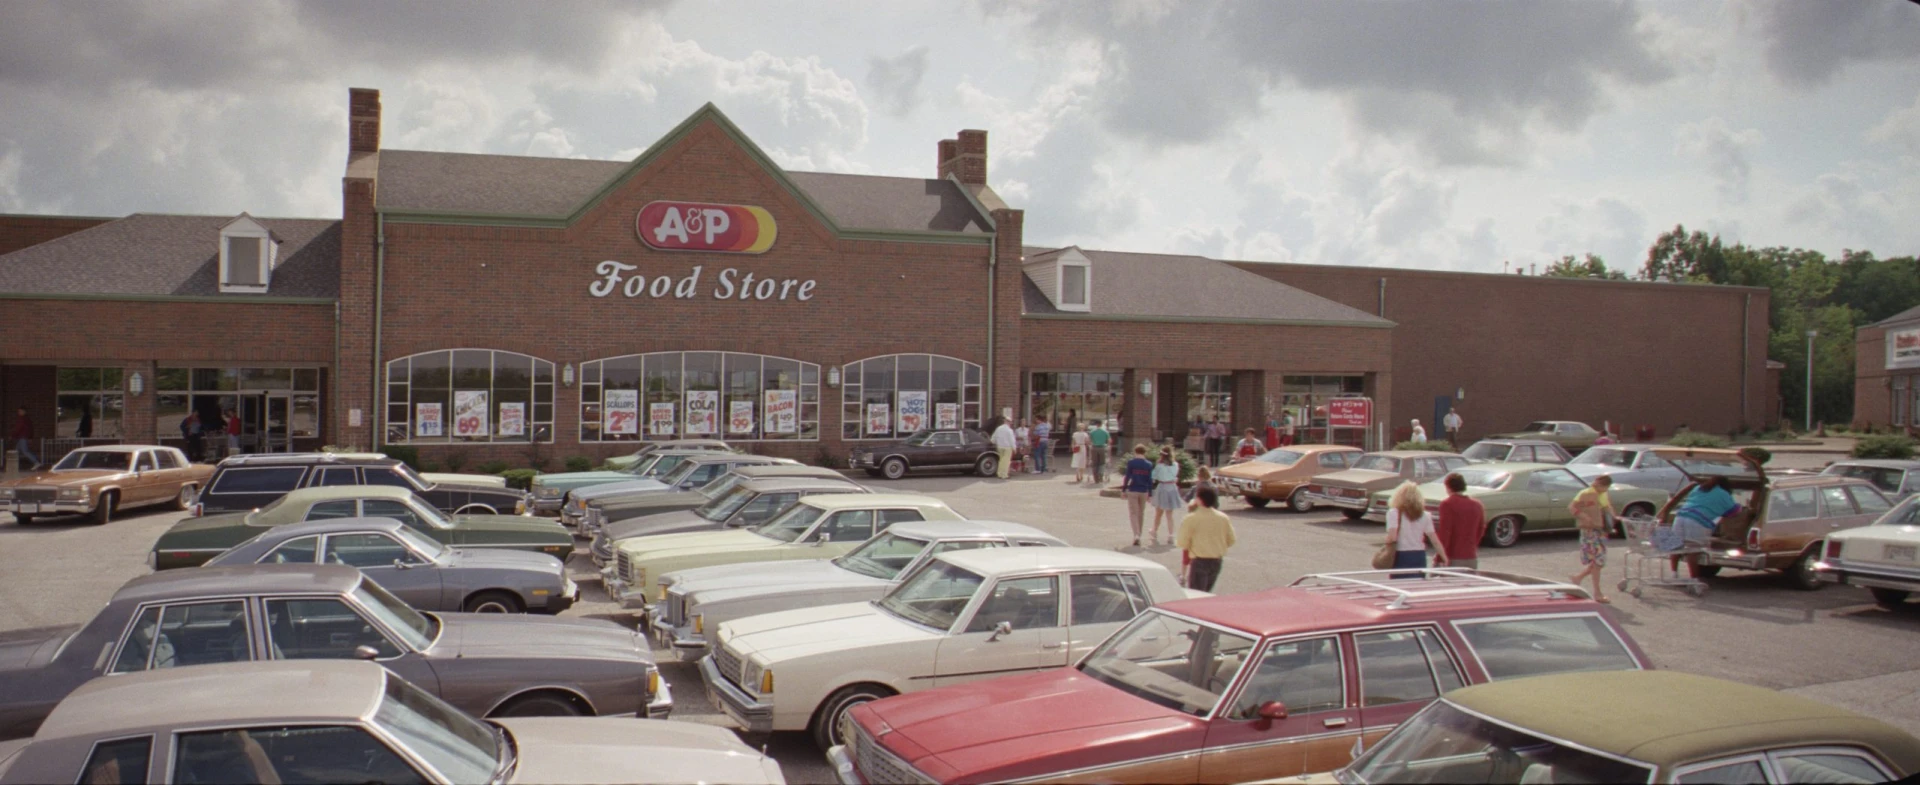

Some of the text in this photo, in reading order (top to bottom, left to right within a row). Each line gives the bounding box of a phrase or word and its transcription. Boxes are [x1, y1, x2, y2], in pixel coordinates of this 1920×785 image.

[654, 207, 730, 245] A&P
[589, 260, 817, 301] Food Store
[606, 401, 635, 409] SCALLOPS
[689, 400, 715, 411] COLA
[768, 401, 793, 413] BACON
[458, 416, 480, 434] 89
